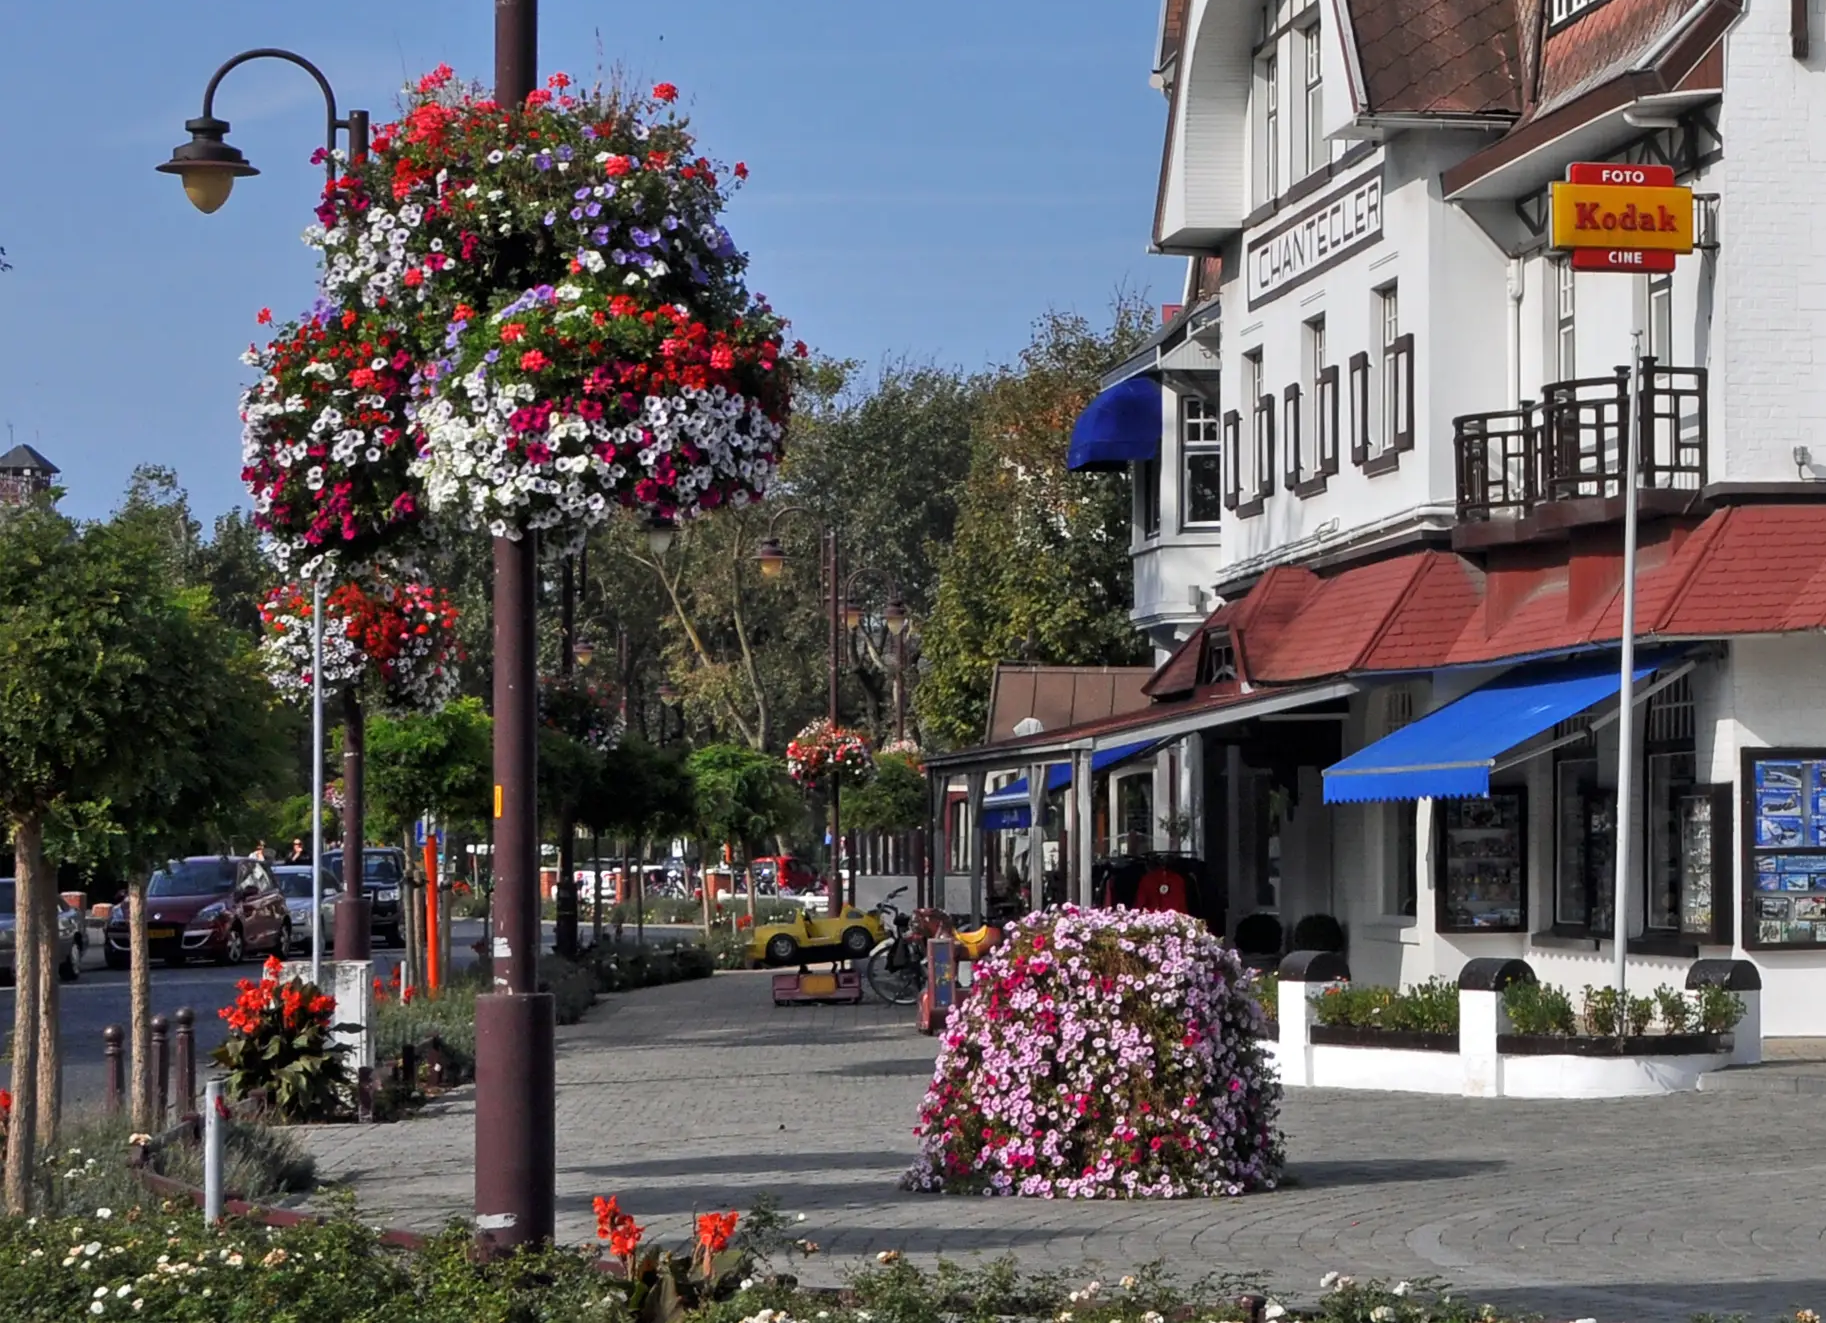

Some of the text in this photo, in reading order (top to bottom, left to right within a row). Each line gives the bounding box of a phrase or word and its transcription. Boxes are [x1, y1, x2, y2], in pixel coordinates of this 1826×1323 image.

[1601, 169, 1646, 184] FOTO
[1573, 201, 1680, 233] Kodak
[1258, 180, 1380, 289] CHANTECLER
[1607, 250, 1643, 265] CINE
